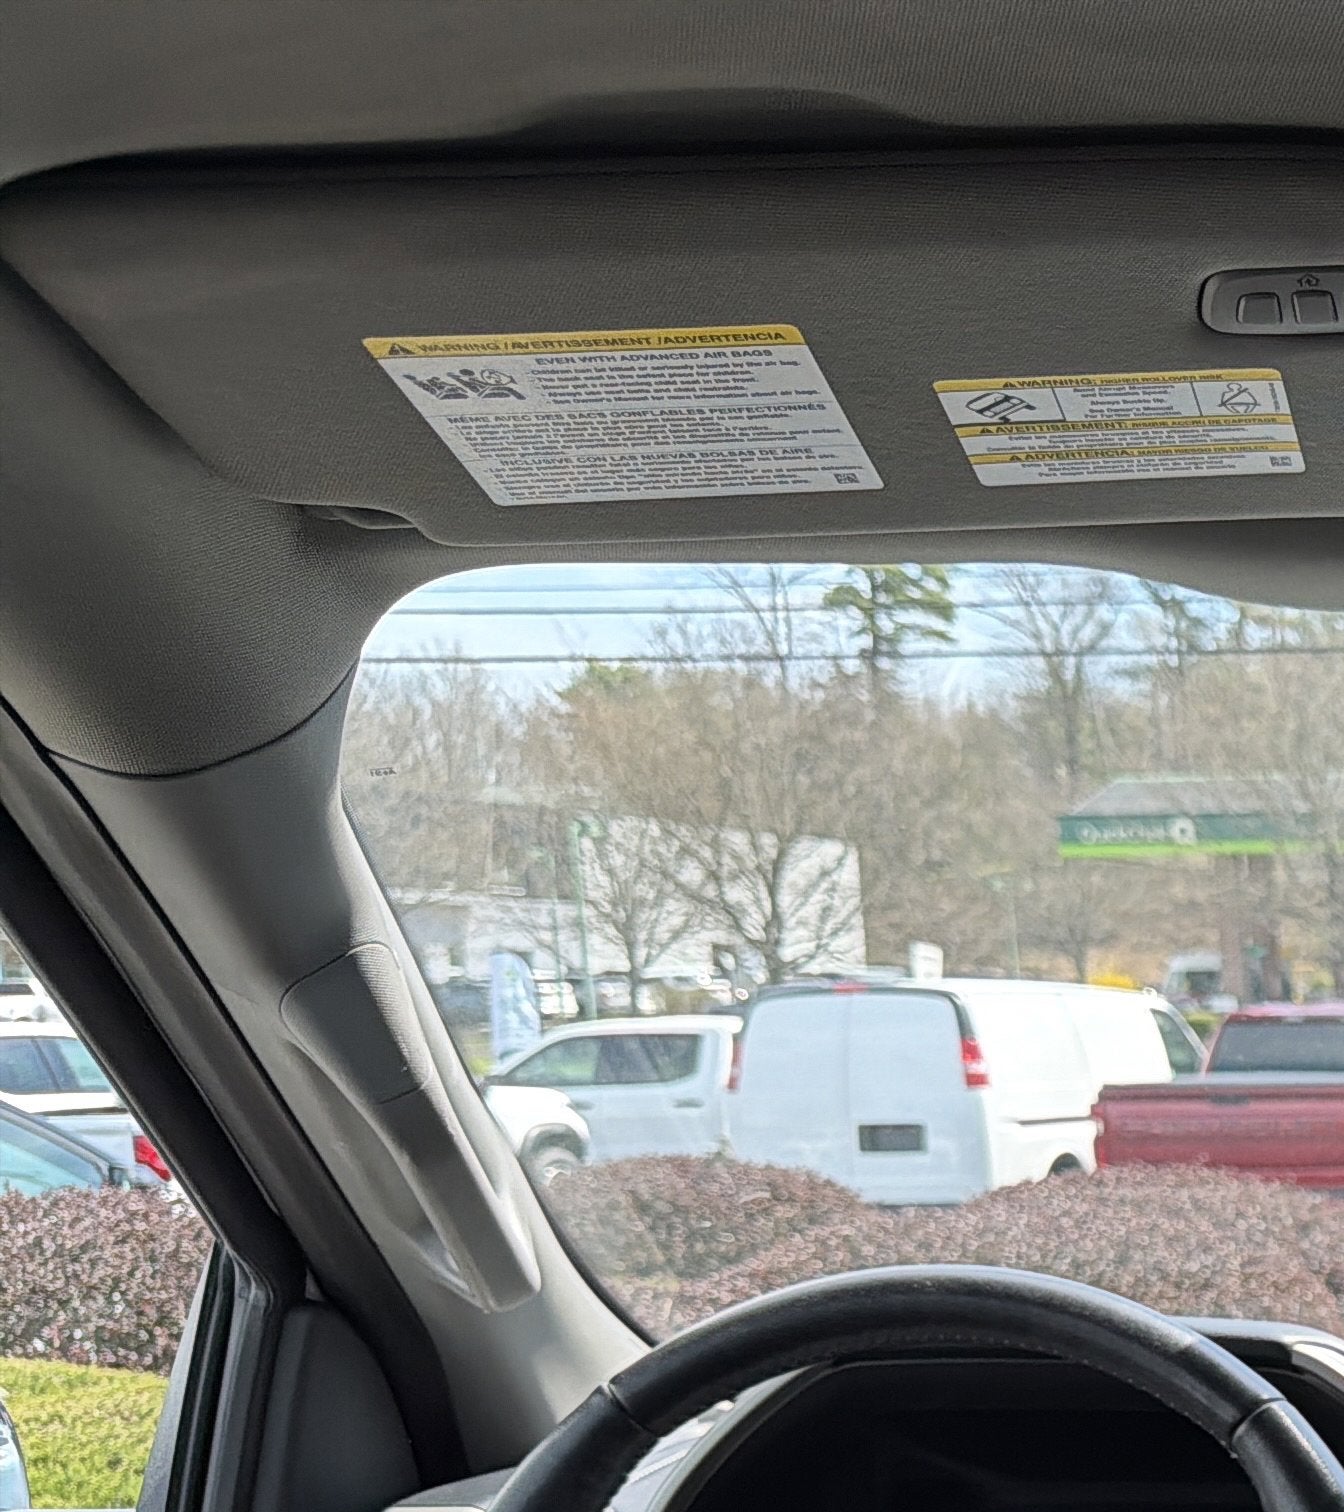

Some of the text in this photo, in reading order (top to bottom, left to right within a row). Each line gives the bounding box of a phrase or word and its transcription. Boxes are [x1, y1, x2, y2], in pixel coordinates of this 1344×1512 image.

[416, 341, 500, 353] WARNING
[535, 349, 773, 365] EVEN WITH ADVANCED AIR BAGS
[1015, 377, 1097, 388] WARNING:
[1140, 374, 1197, 384] ROLLOVER
[494, 414, 532, 423] AVEC
[535, 413, 565, 421] DES
[567, 411, 607, 420] SACS
[610, 408, 706, 418] GONFLABLES
[500, 457, 574, 466] INCLUSIVE
[576, 455, 608, 464] CON
[610, 454, 638, 462] LAS
[641, 452, 697, 461] NUEVAS
[700, 450, 757, 459] BOLSAS
[781, 447, 813, 455] AIRE
